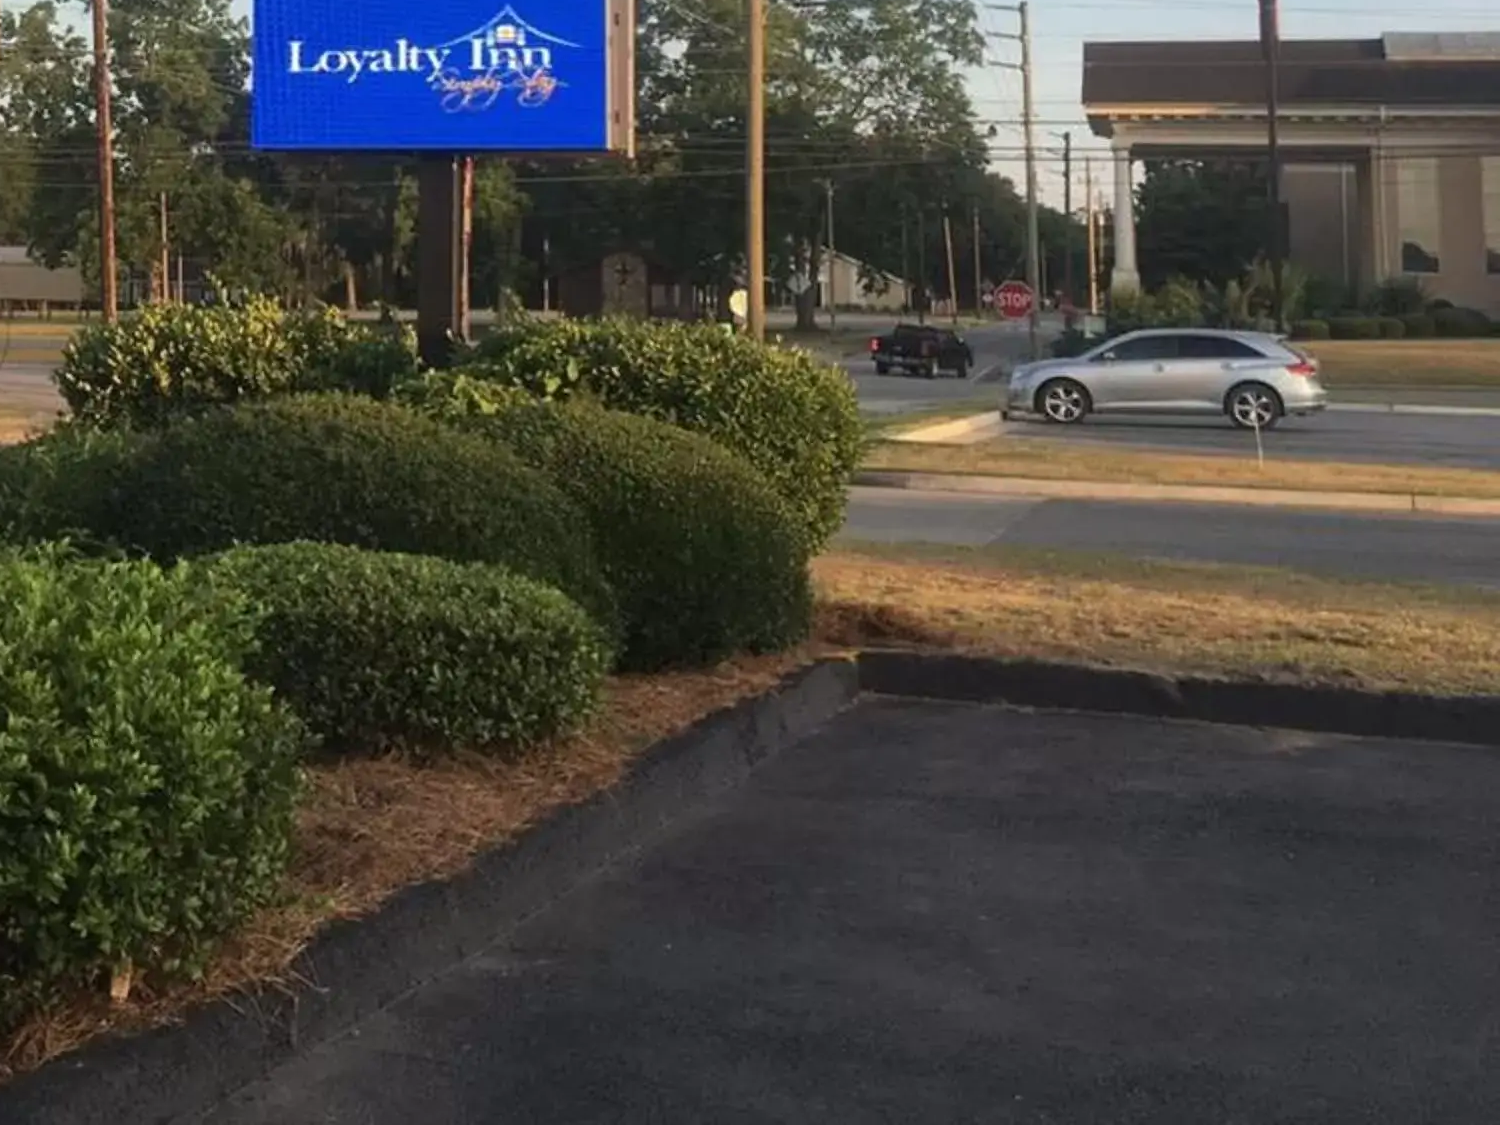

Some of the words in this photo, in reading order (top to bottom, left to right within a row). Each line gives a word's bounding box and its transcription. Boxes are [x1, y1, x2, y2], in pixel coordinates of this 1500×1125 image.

[287, 38, 451, 83] Loyalty
[468, 38, 552, 70] Inn
[999, 292, 1031, 307] STOP
